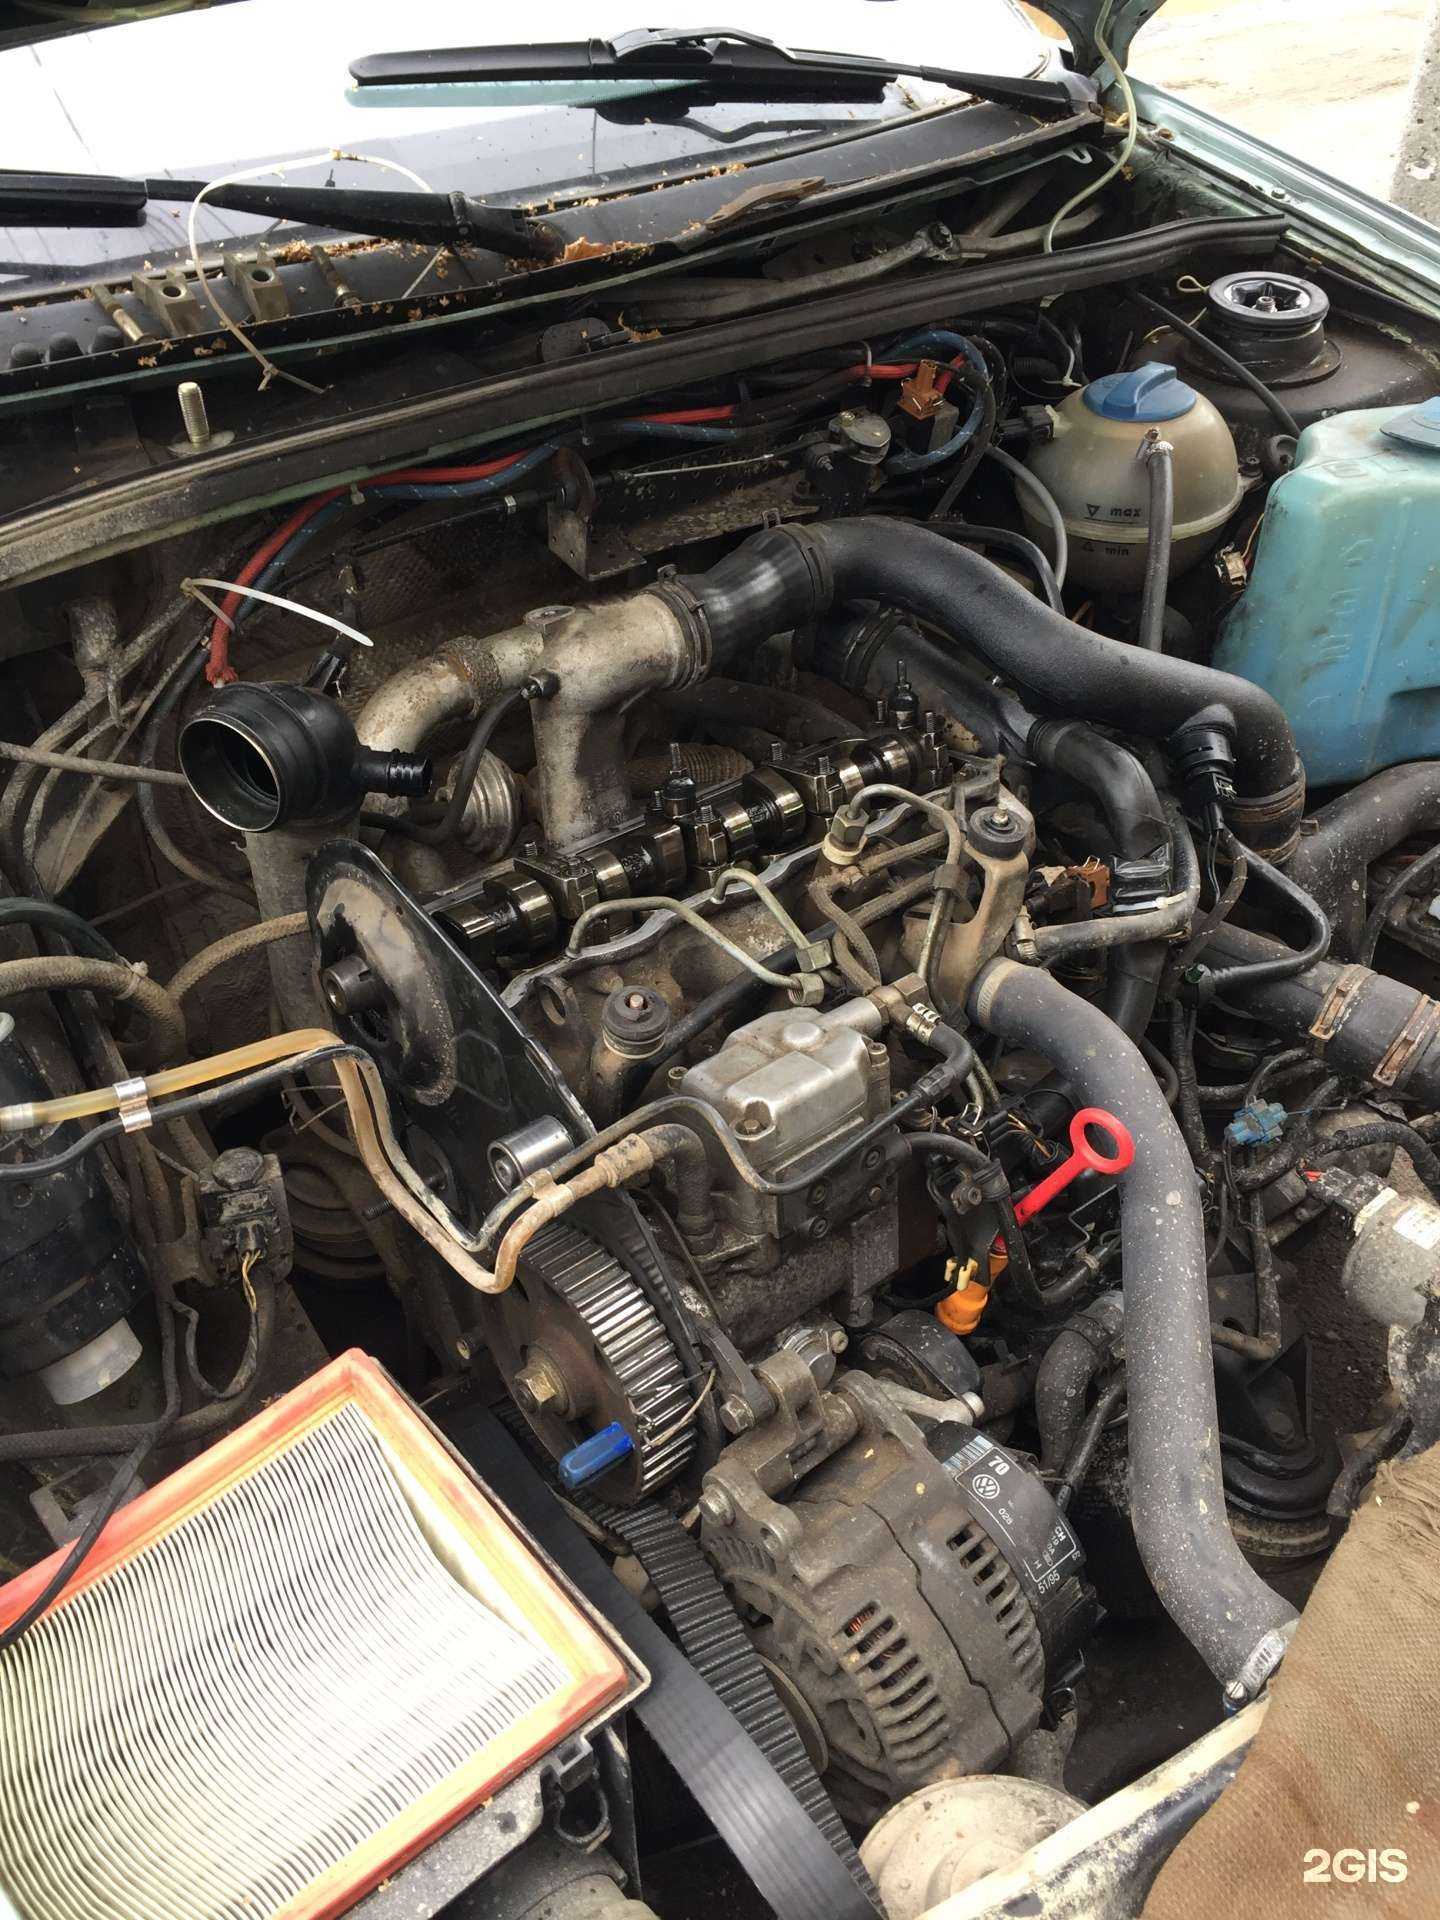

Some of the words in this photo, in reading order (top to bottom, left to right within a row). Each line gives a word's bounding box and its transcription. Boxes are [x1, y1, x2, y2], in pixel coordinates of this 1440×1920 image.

[1110, 506, 1141, 518] max
[1105, 544, 1129, 556] min
[988, 1455, 1011, 1475] 70
[1038, 1571, 1061, 1594] 51/95
